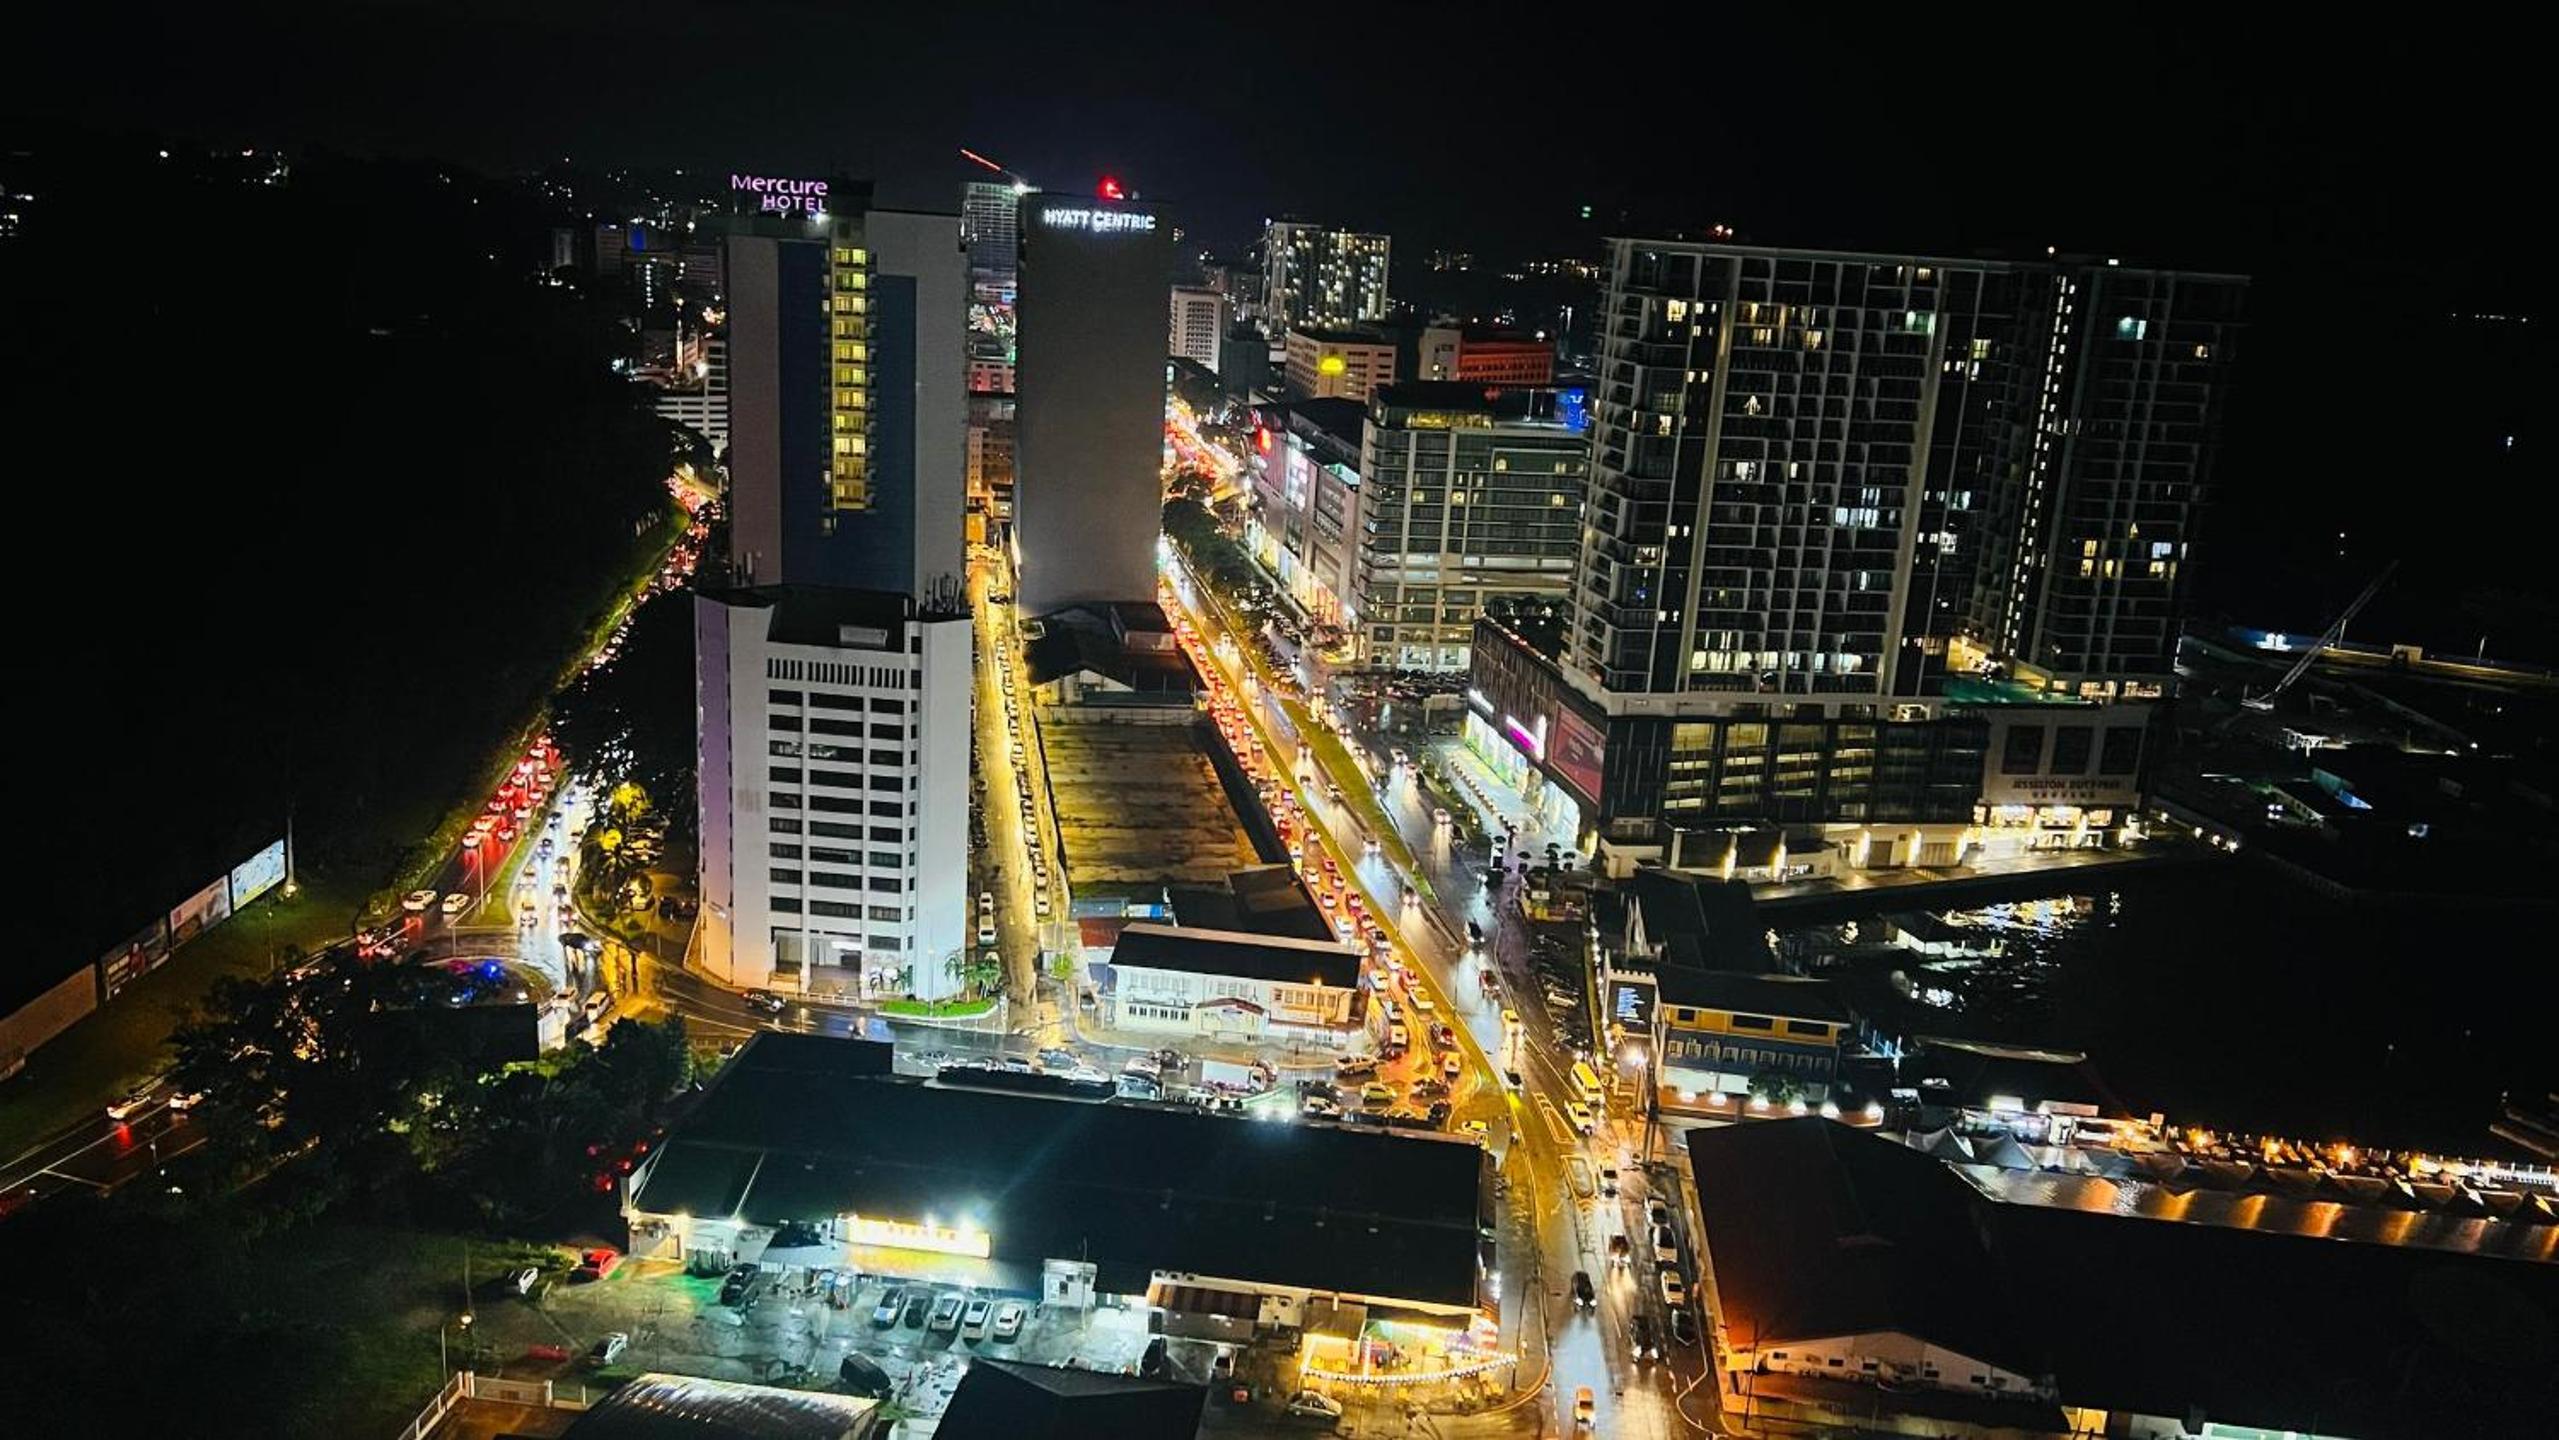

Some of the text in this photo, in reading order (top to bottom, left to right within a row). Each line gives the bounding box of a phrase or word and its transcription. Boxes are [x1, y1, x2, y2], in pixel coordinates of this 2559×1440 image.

[731, 174, 828, 196] Mercure
[763, 194, 828, 213] HOTEL
[1043, 208, 1156, 231] HYATT CENTRIC
